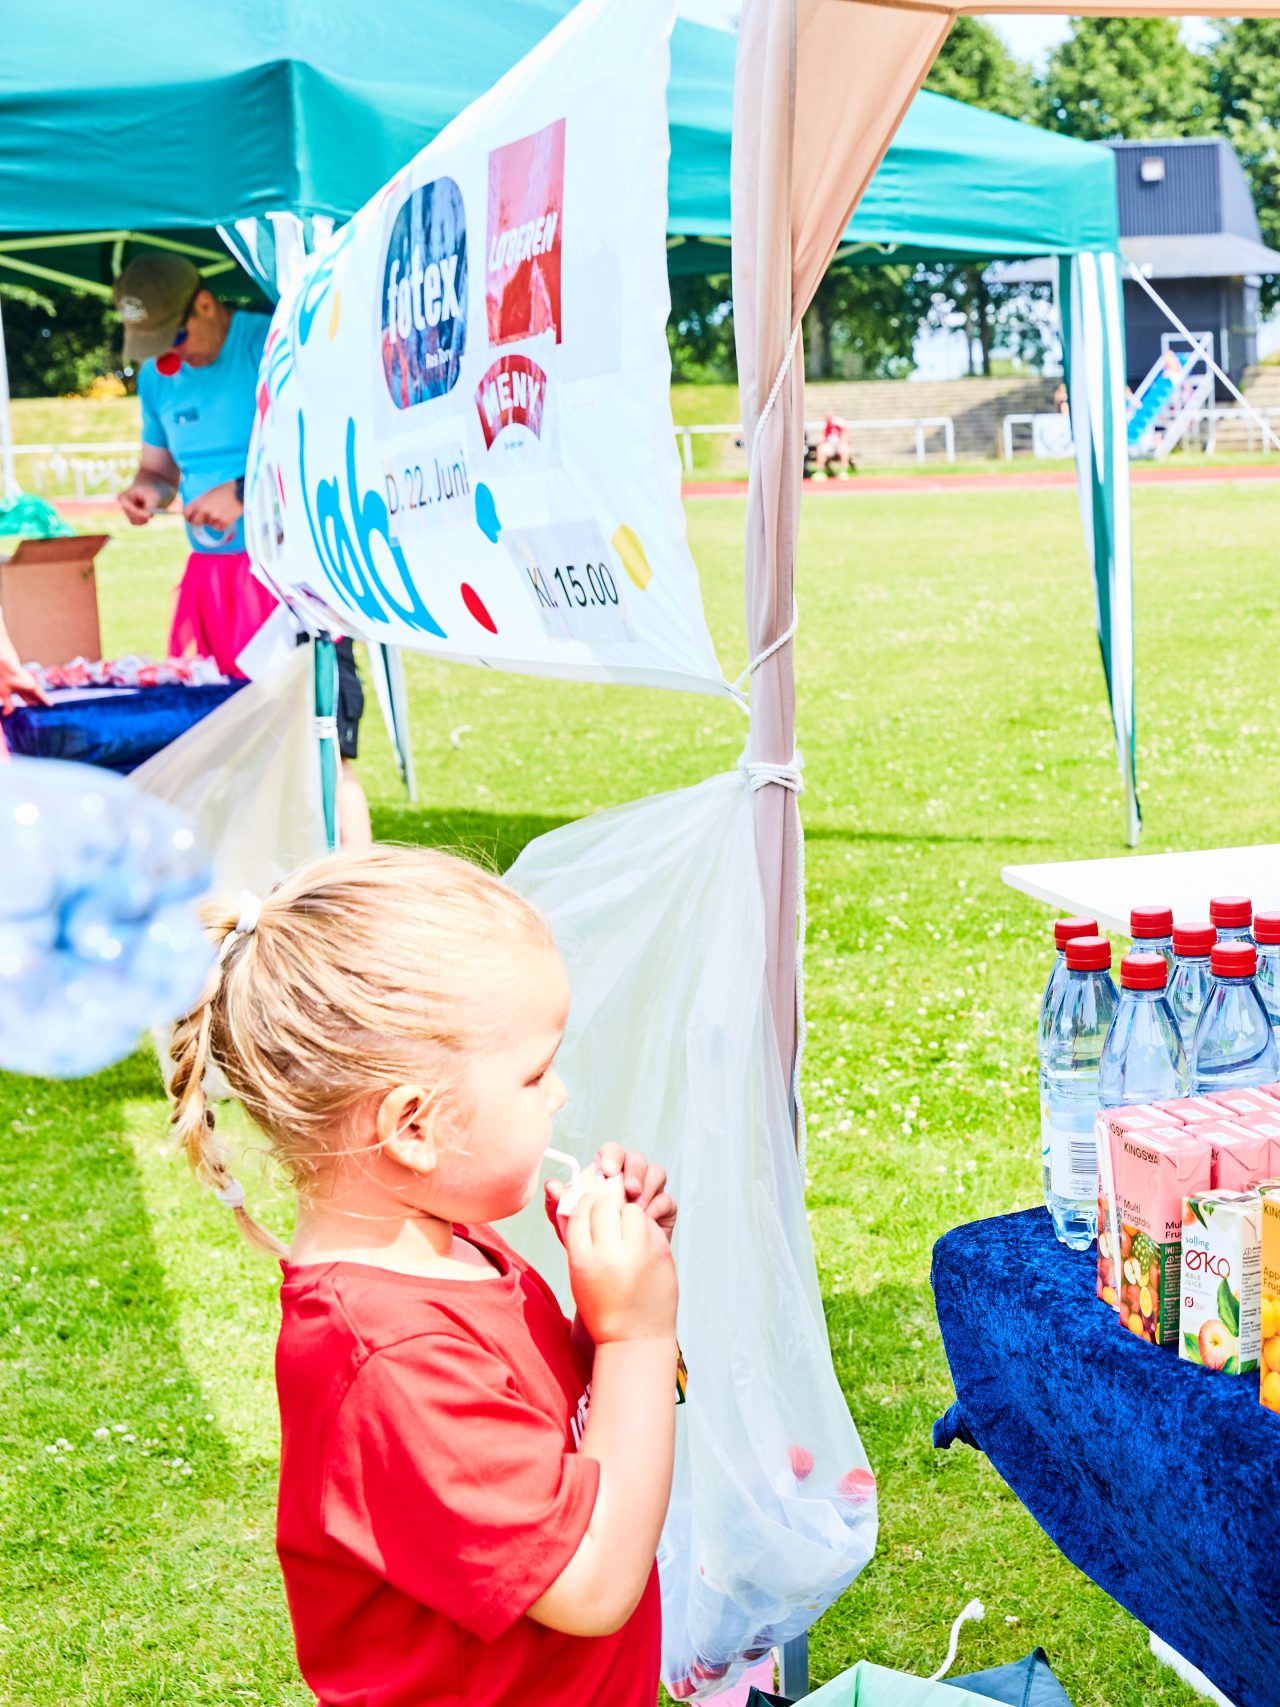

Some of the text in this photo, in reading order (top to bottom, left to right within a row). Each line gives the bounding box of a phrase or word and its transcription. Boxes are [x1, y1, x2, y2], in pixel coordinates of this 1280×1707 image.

[482, 371, 541, 427] MENY
[385, 450, 470, 515] D. 22. Juni
[554, 562, 619, 608] 15.00
[1185, 1236, 1210, 1251] salling
